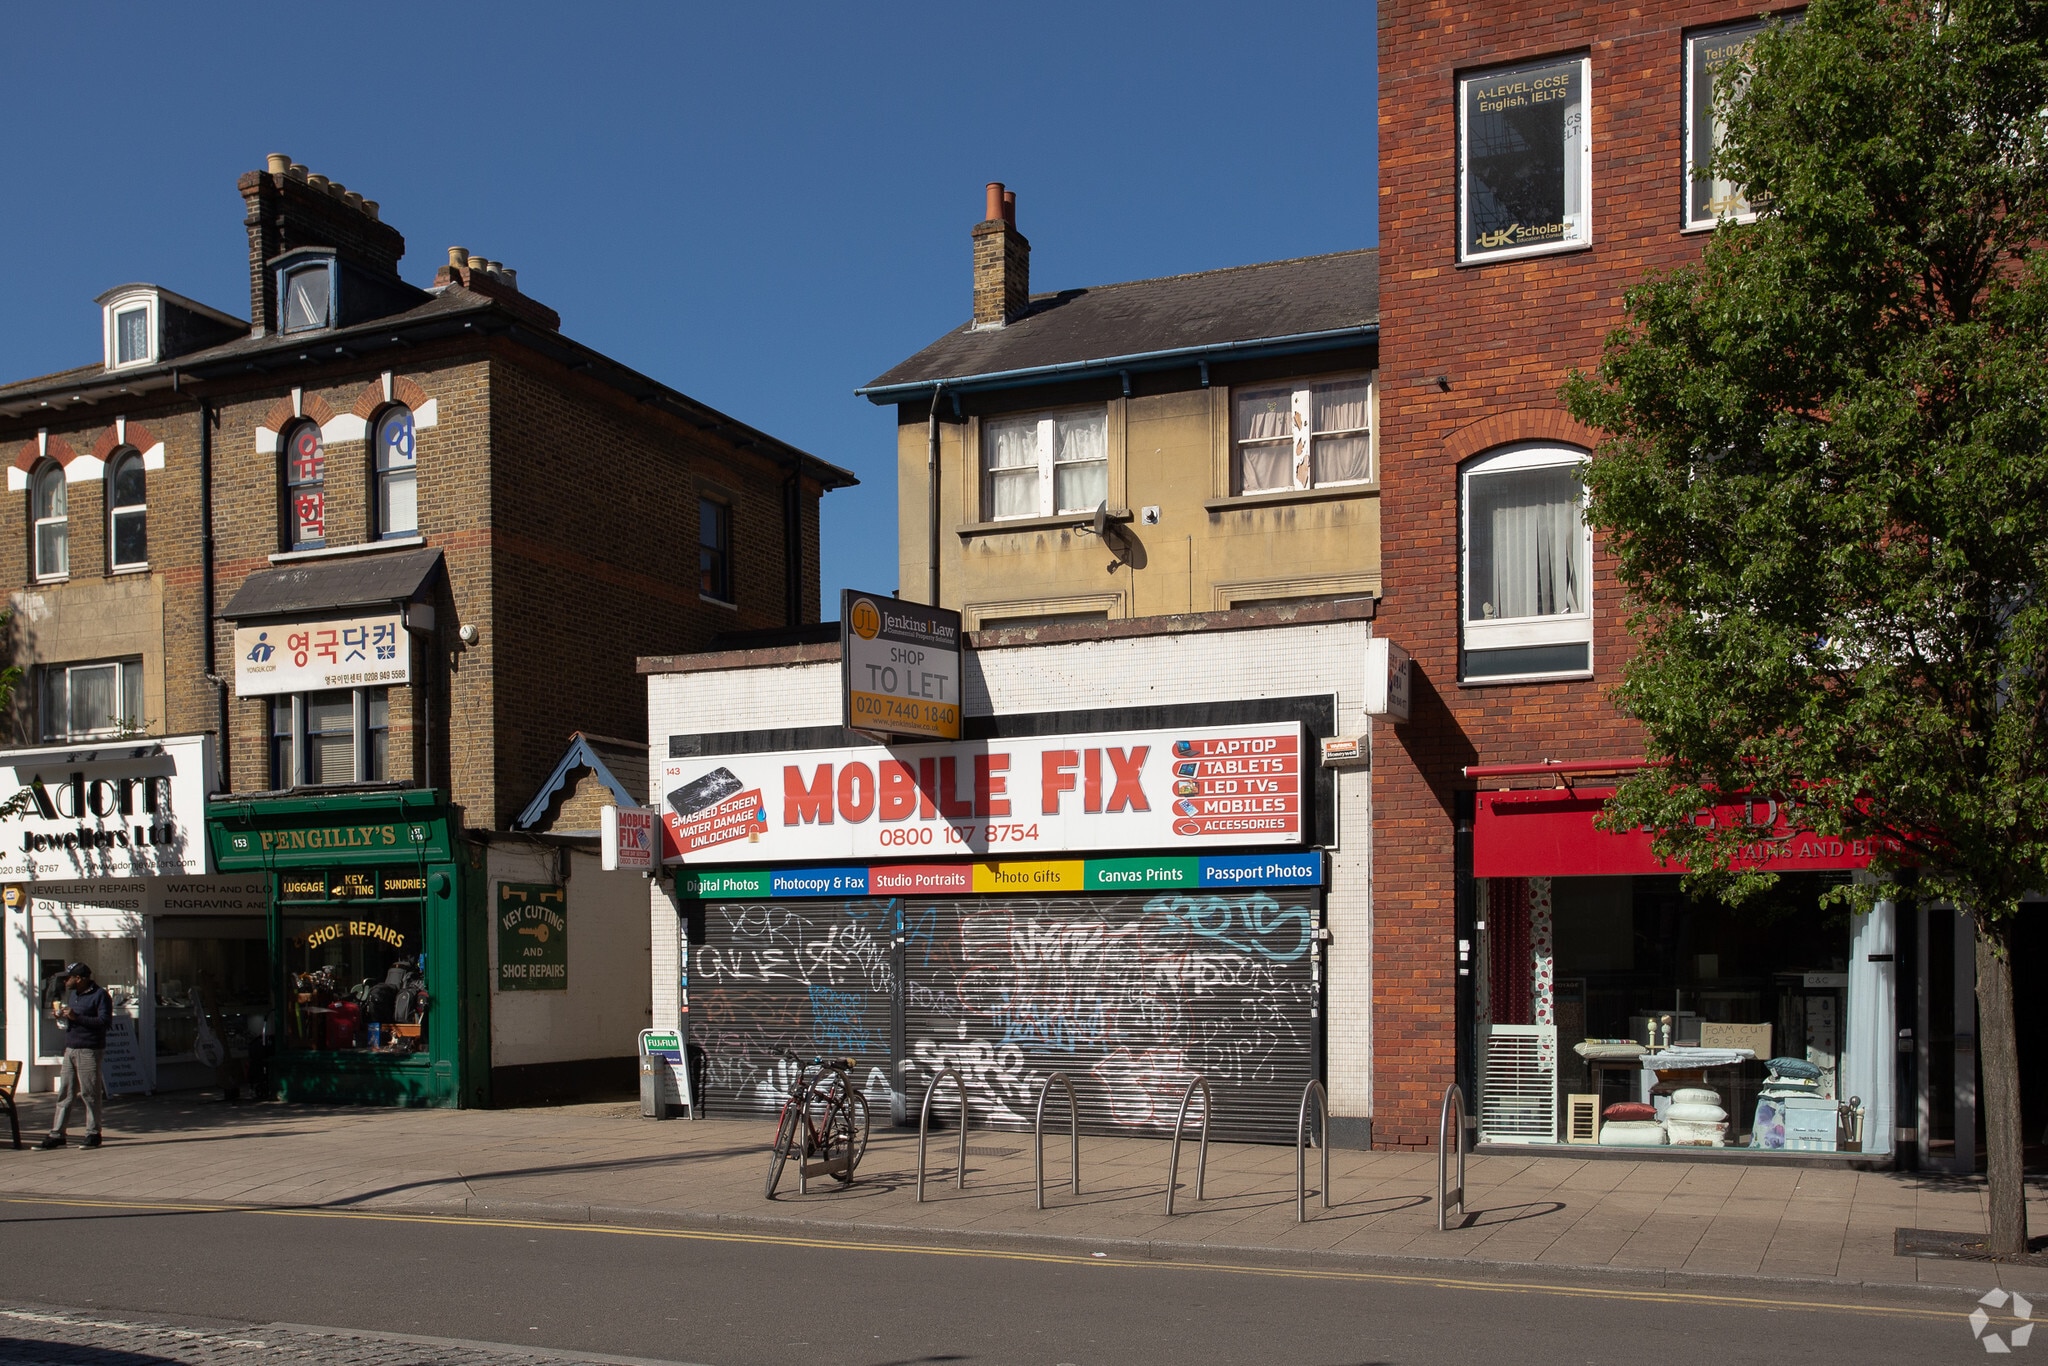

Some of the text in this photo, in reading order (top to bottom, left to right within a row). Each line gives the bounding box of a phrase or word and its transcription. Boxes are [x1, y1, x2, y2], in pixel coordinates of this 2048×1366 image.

[1480, 87, 1567, 112] English, IELTS
[883, 611, 954, 638] Jenkins Law
[288, 623, 395, 667] 영국닷컴
[891, 647, 924, 665] SHOP
[866, 663, 948, 699] TO LET
[856, 696, 953, 724] 020 7440 1840
[873, 718, 939, 731] www.jenkinslaw.co.uk
[1204, 738, 1276, 755] LAPTOP
[1327, 750, 1356, 758] Honeywell
[666, 767, 681, 776] 143
[1204, 758, 1283, 774] TABLETS
[783, 745, 1152, 827] MOBILE FIX
[1204, 779, 1278, 794] LED TVs
[19, 772, 172, 822] Adorn
[671, 795, 758, 828] SMASHED SCREEN
[1204, 798, 1286, 813] MOBILES
[619, 812, 650, 828] MOBILE
[679, 809, 754, 838] WATER DAMAGE
[1204, 818, 1285, 831] ACCESSORIES
[19, 823, 172, 853] Jewellers Ltd
[619, 828, 639, 848] FIX
[690, 825, 746, 848] UNLOCKING
[880, 824, 1039, 846] 0800 107 8754
[234, 839, 247, 848] 153
[1799, 842, 1844, 858] AND
[39, 864, 59, 873] 8767
[994, 870, 1061, 883] Photo Gifts
[1098, 868, 1183, 883] Canvas Prints
[1206, 865, 1312, 882] Passport Photos
[283, 882, 324, 893] LUGGAGE
[384, 878, 426, 890] SUNDRIES
[687, 877, 759, 894] Digital Photos
[774, 876, 864, 892] Photocopy & Fax
[876, 873, 966, 887] Studio Portraits
[31, 883, 146, 895] JEWELLERY REPAIRS
[167, 883, 215, 894] WATCH
[220, 886, 242, 894] AND
[38, 899, 139, 910] ON THE PREMISES
[164, 899, 242, 910] ENGRAVING
[503, 905, 564, 931] KEY CUTTING
[308, 921, 404, 949] SHOE REPAIRS
[523, 948, 543, 956] AND
[503, 964, 564, 977] SHOE REPAIRS
[1705, 1025, 1765, 1034] FOAM CUT
[648, 1039, 677, 1047] FUJIFILM
[1706, 1035, 1752, 1044] TO SIZE
